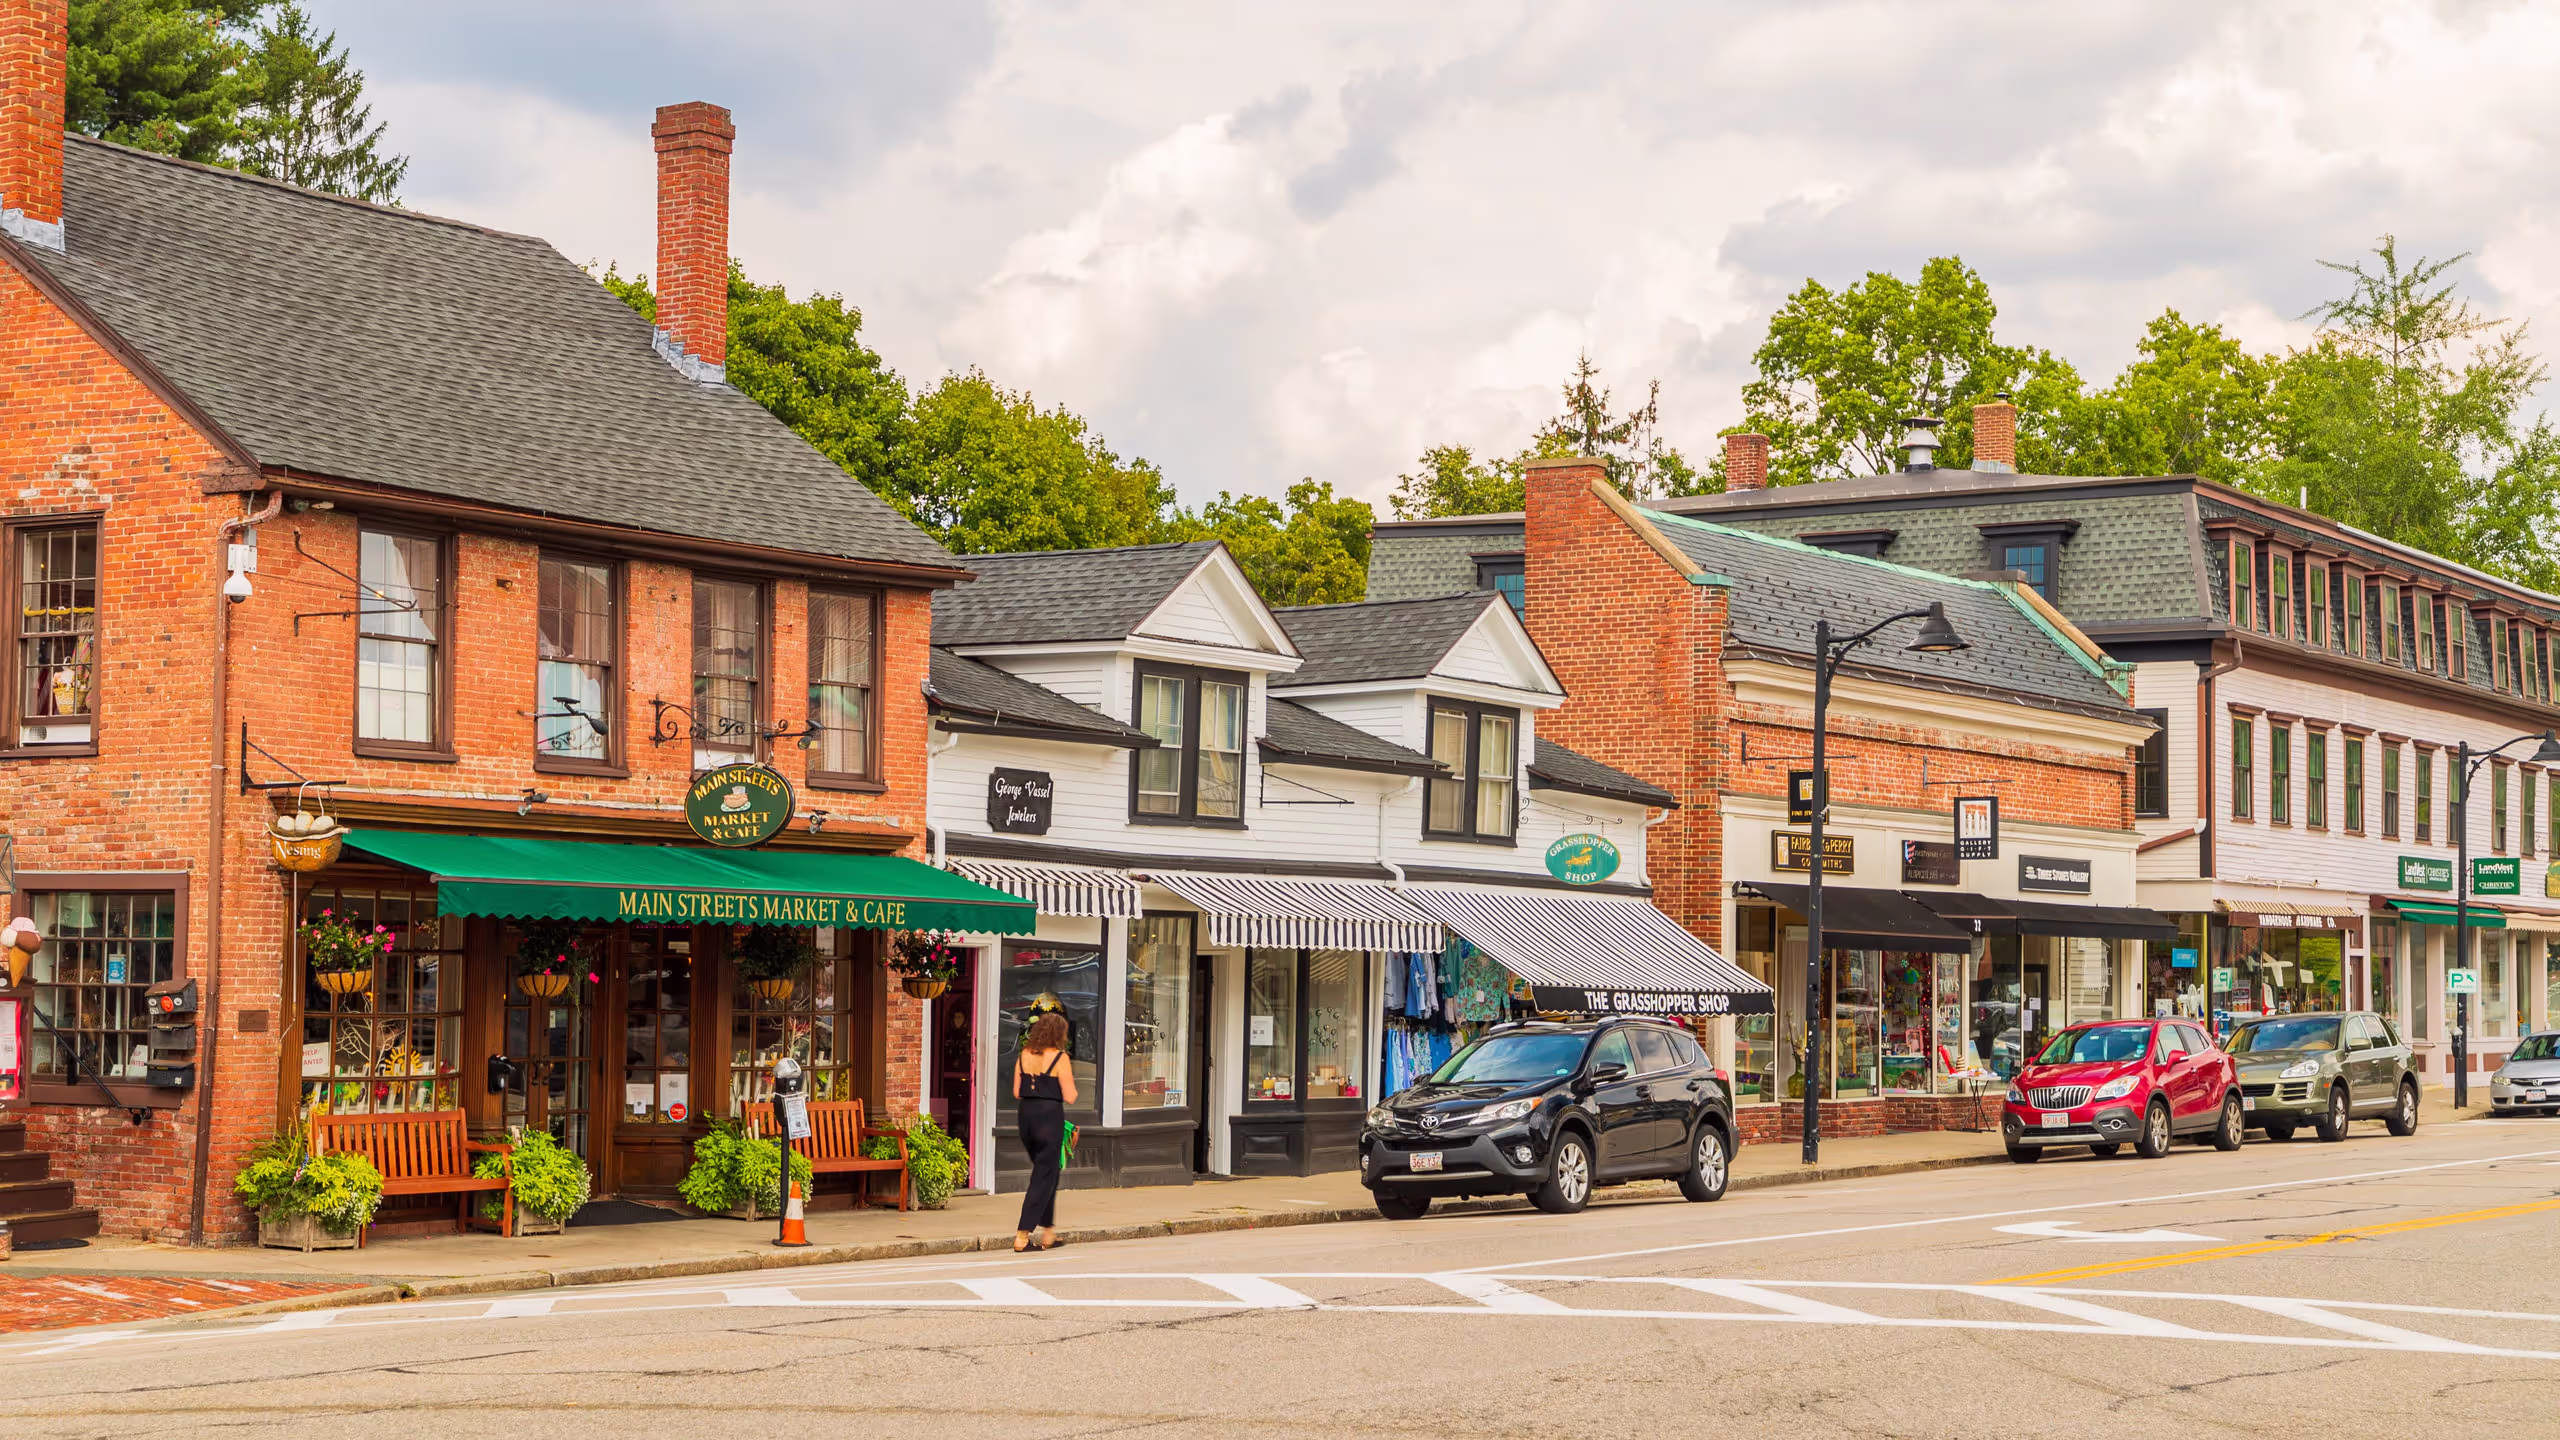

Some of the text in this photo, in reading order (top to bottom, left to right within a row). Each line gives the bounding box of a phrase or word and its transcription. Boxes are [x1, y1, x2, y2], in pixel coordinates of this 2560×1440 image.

[694, 769, 780, 801] MAIN STREETS
[995, 777, 1051, 800] George Vassel
[704, 811, 771, 826] MARKET
[1006, 806, 1037, 826] Jewelers
[713, 825, 761, 839] & CAFE
[275, 841, 321, 859] Nesting
[1550, 836, 1615, 856] GRASSHOPPER
[1830, 840, 1852, 853] PERRY
[2405, 861, 2425, 876] LandVest
[1565, 871, 1597, 882] SHOP
[619, 892, 905, 925] MAIN STREETS MARKET & CAFE
[1938, 978, 1960, 992] TOYS
[2452, 973, 2463, 988] P
[1584, 991, 1730, 1012] THE GRASSHOPPER SHOP
[1938, 1005, 1960, 1018] GIFTS
[1166, 1093, 1181, 1105] OPEN
